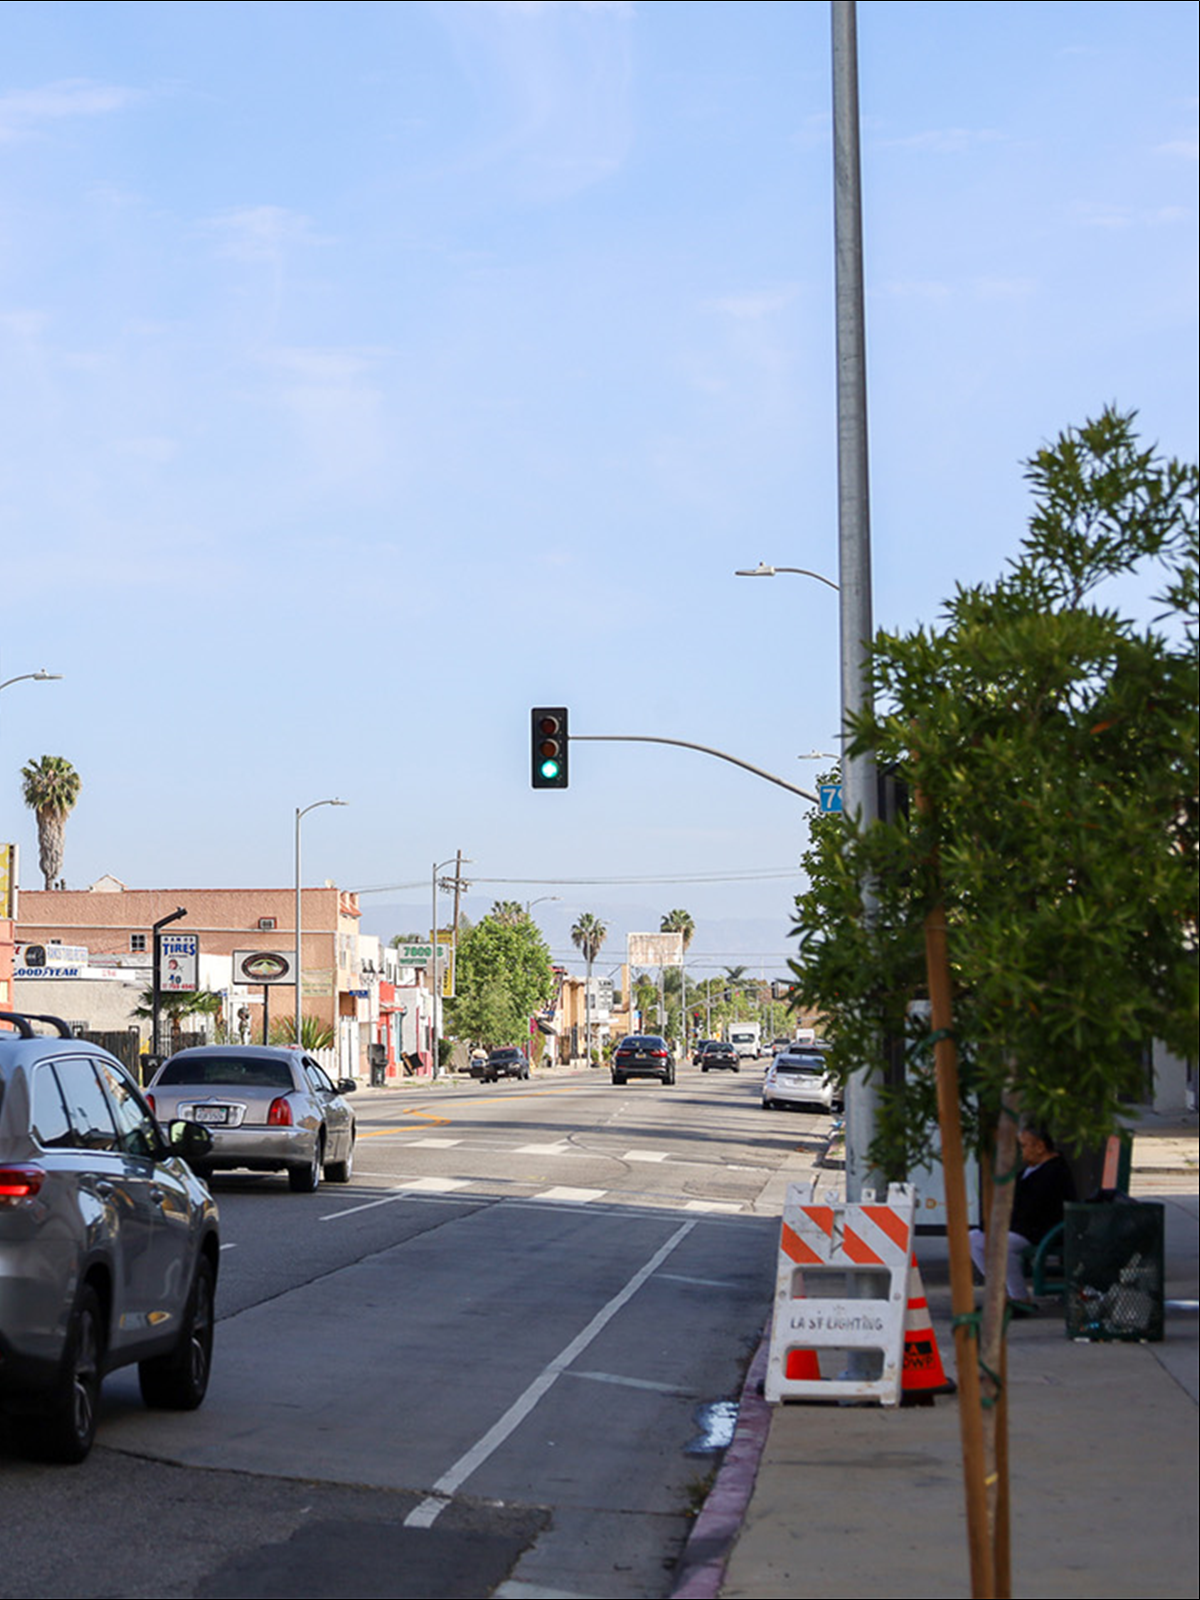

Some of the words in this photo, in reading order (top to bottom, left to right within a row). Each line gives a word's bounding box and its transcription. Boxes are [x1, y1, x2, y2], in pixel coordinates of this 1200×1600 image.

[162, 943, 196, 956] TIRES
[790, 1317, 806, 1330] LA
[808, 1317, 823, 1330] ST
[826, 1316, 884, 1331] LIGHTING
